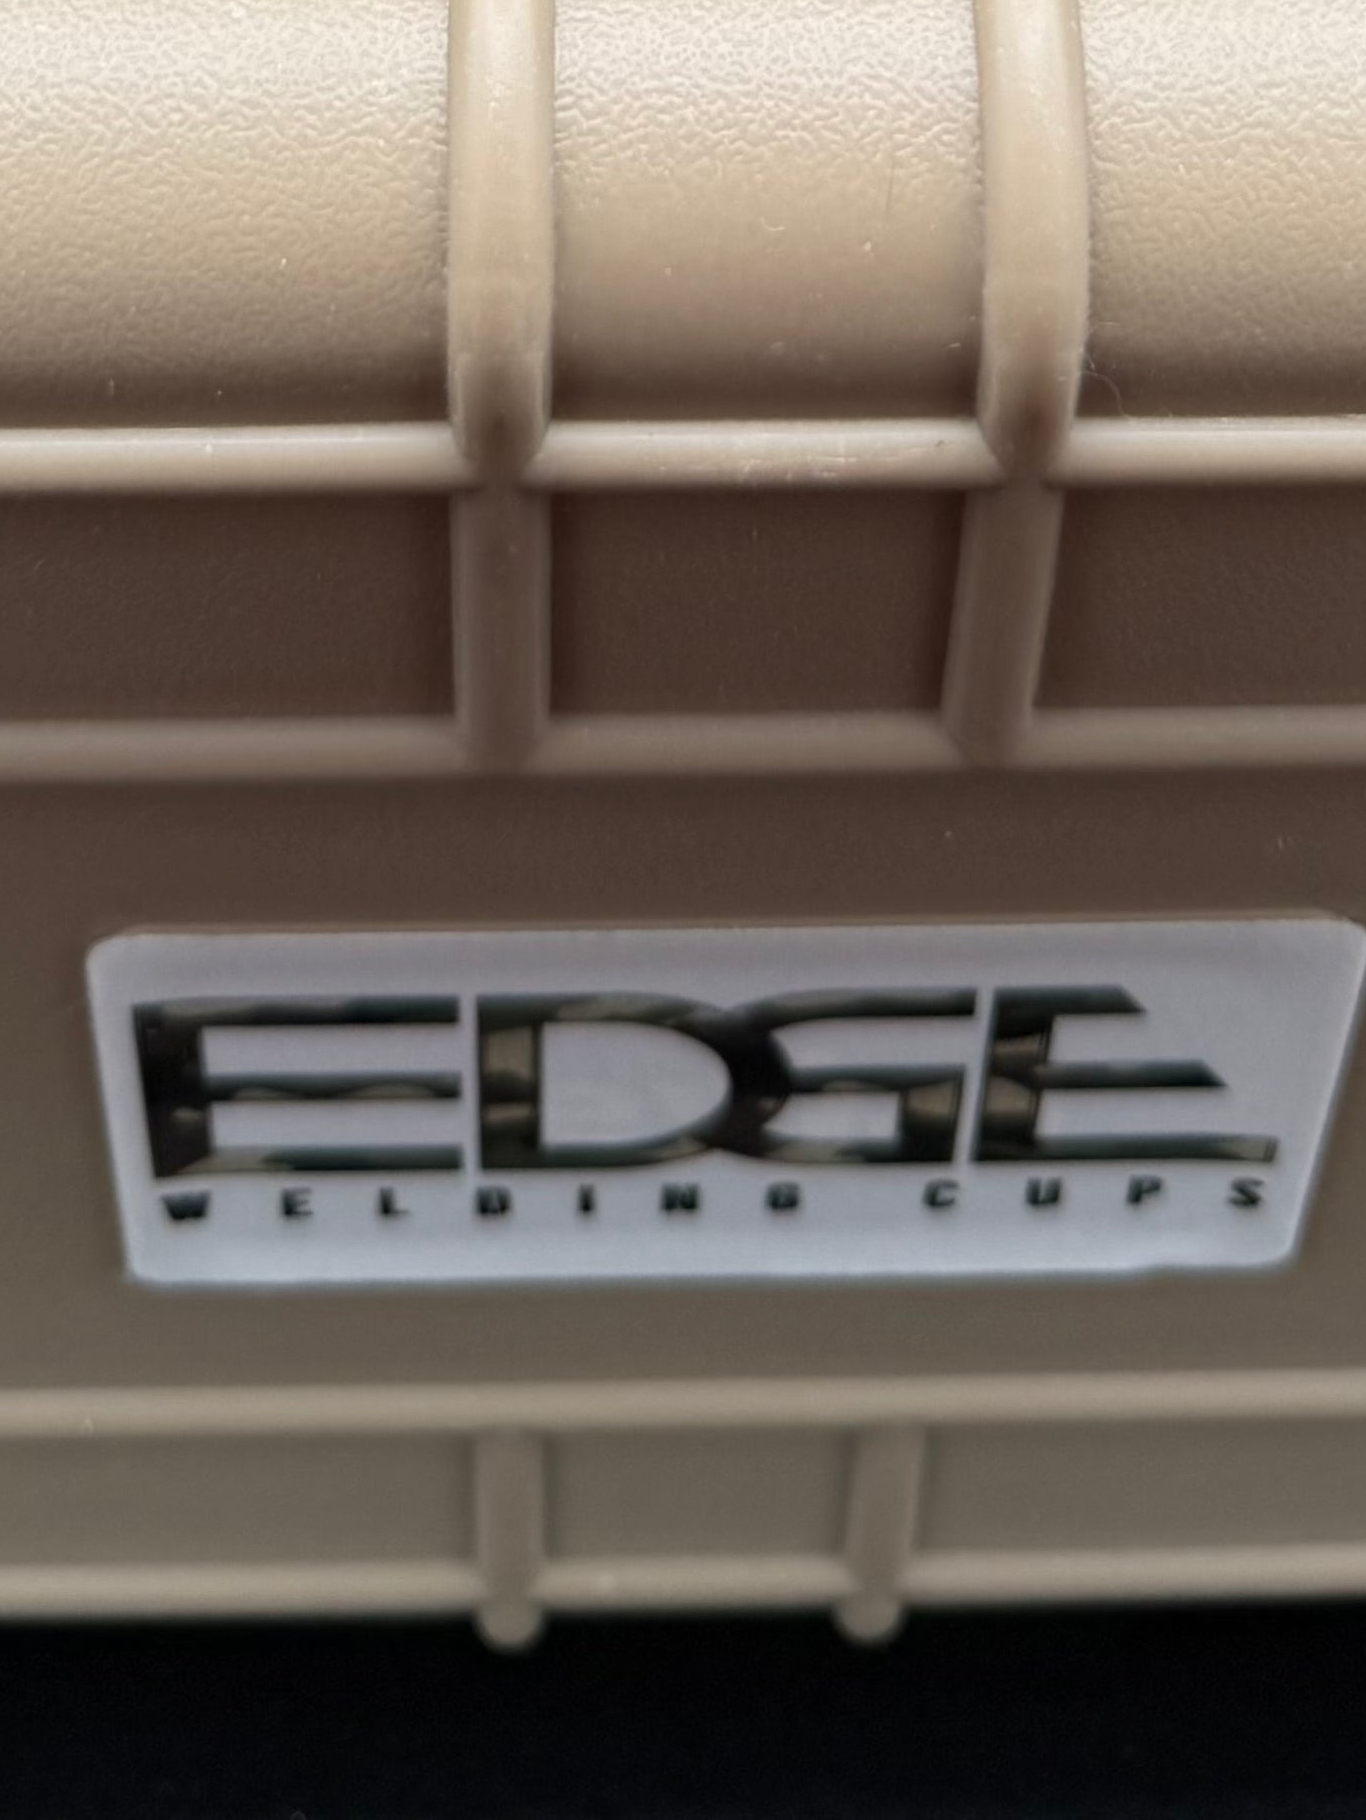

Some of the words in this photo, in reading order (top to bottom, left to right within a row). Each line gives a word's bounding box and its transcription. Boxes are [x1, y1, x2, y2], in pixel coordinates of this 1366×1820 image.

[131, 985, 1279, 1180] EDGE
[159, 1182, 803, 1225] WELDING
[919, 1175, 1267, 1213] CUPS
